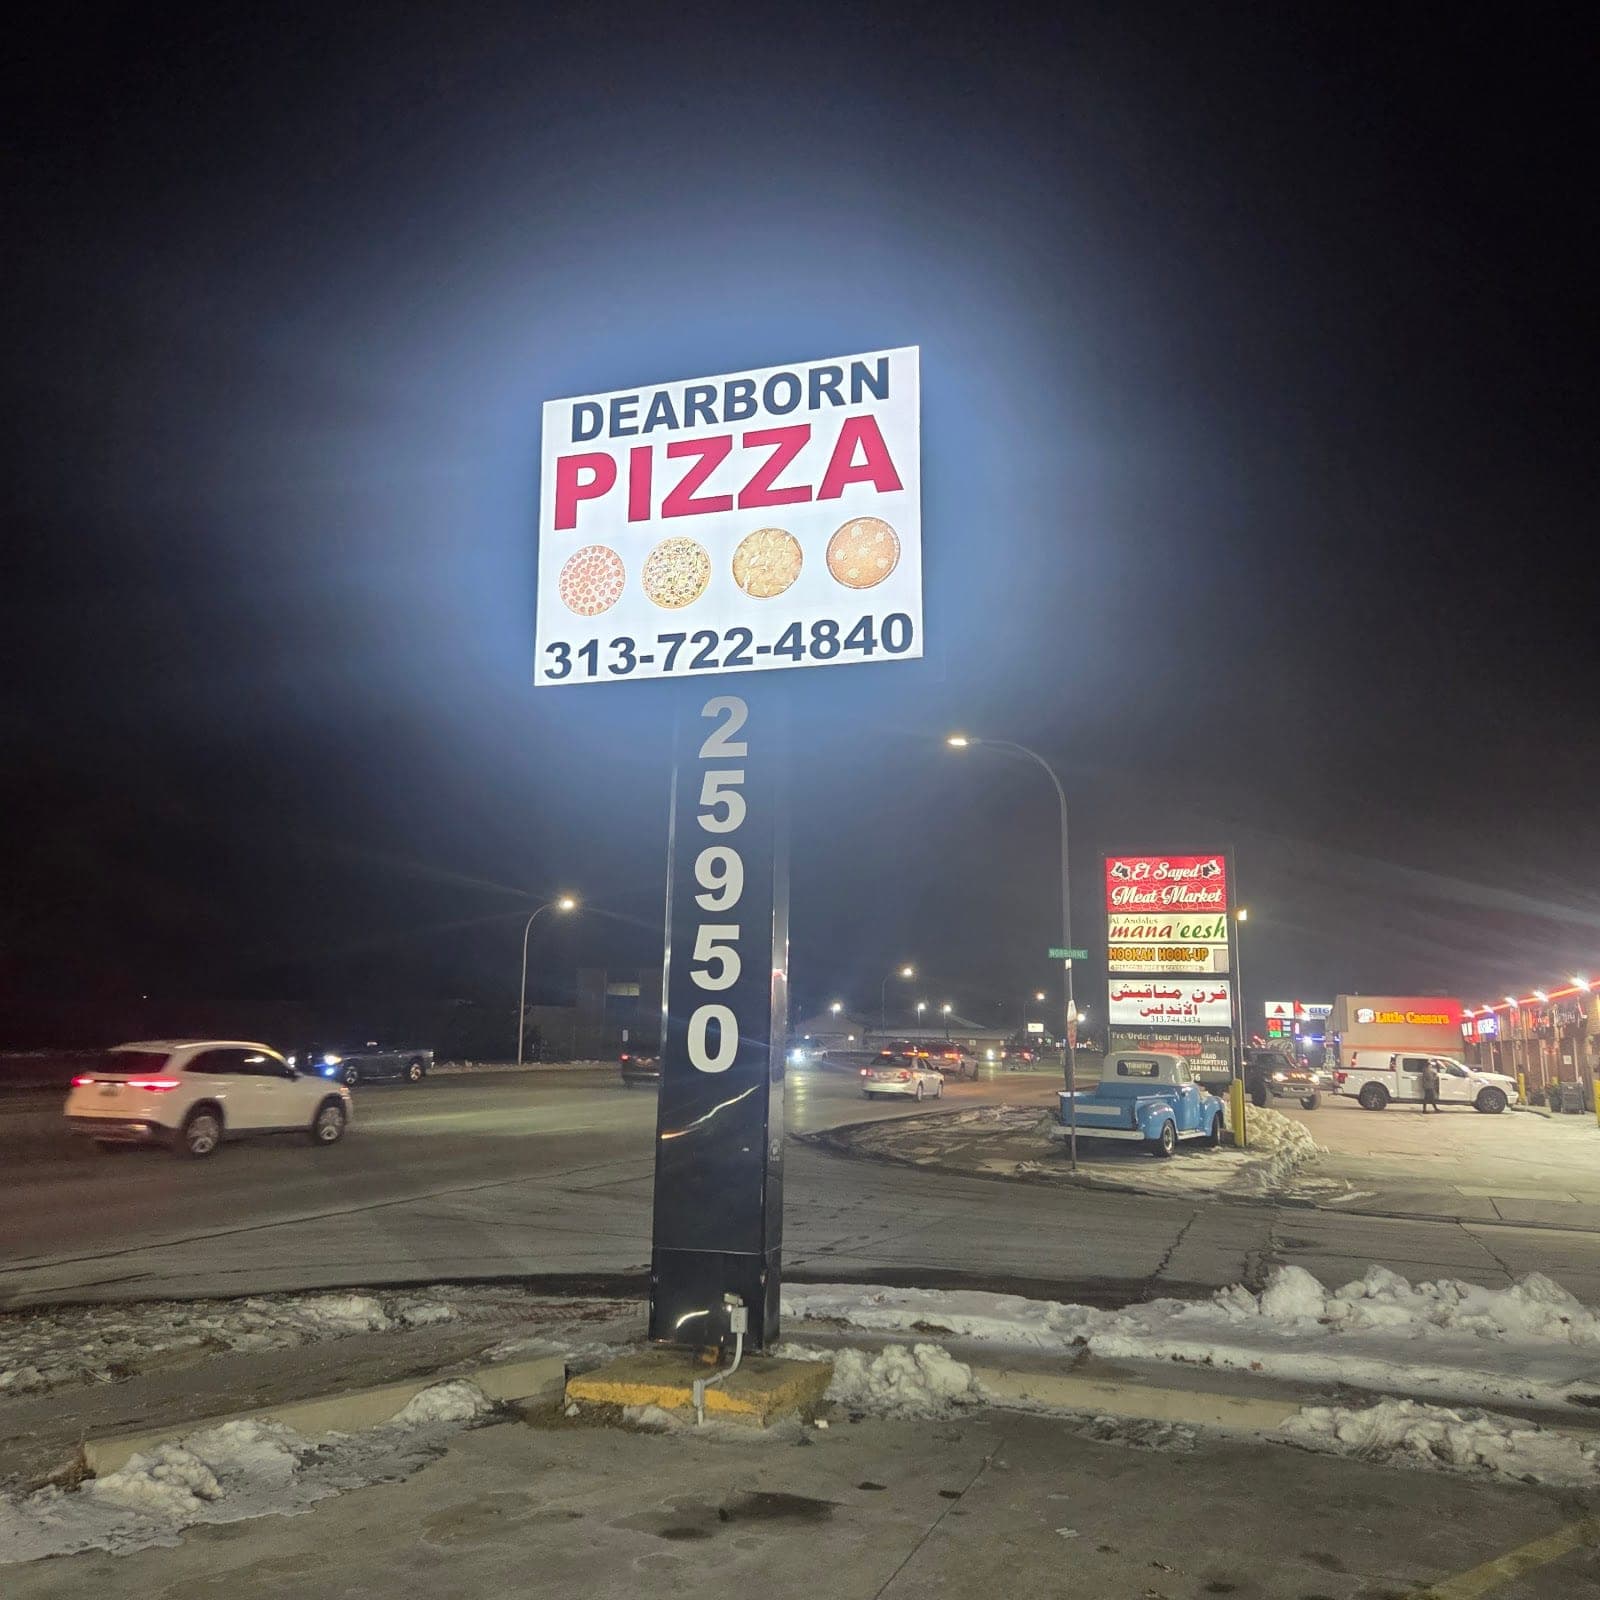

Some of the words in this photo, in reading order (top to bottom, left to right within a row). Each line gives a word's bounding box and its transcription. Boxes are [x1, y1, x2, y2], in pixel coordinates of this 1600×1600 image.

[571, 357, 890, 443] DEARBORN
[554, 414, 904, 531] PIZZA
[544, 612, 914, 680] 313-722-4840
[1132, 862, 1150, 881] El
[1153, 861, 1201, 881] Sayed
[1111, 886, 1158, 905] Meat
[1161, 885, 1223, 905] Market
[1109, 947, 1155, 961] HOOKAH
[1158, 947, 1210, 962] HOOK-UP
[1111, 984, 1182, 1003] مناقيش
[1192, 984, 1228, 1003] فرن
[1376, 1011, 1404, 1023] Little
[1406, 1011, 1450, 1024] Caesars
[1204, 1034, 1230, 1044] Today
